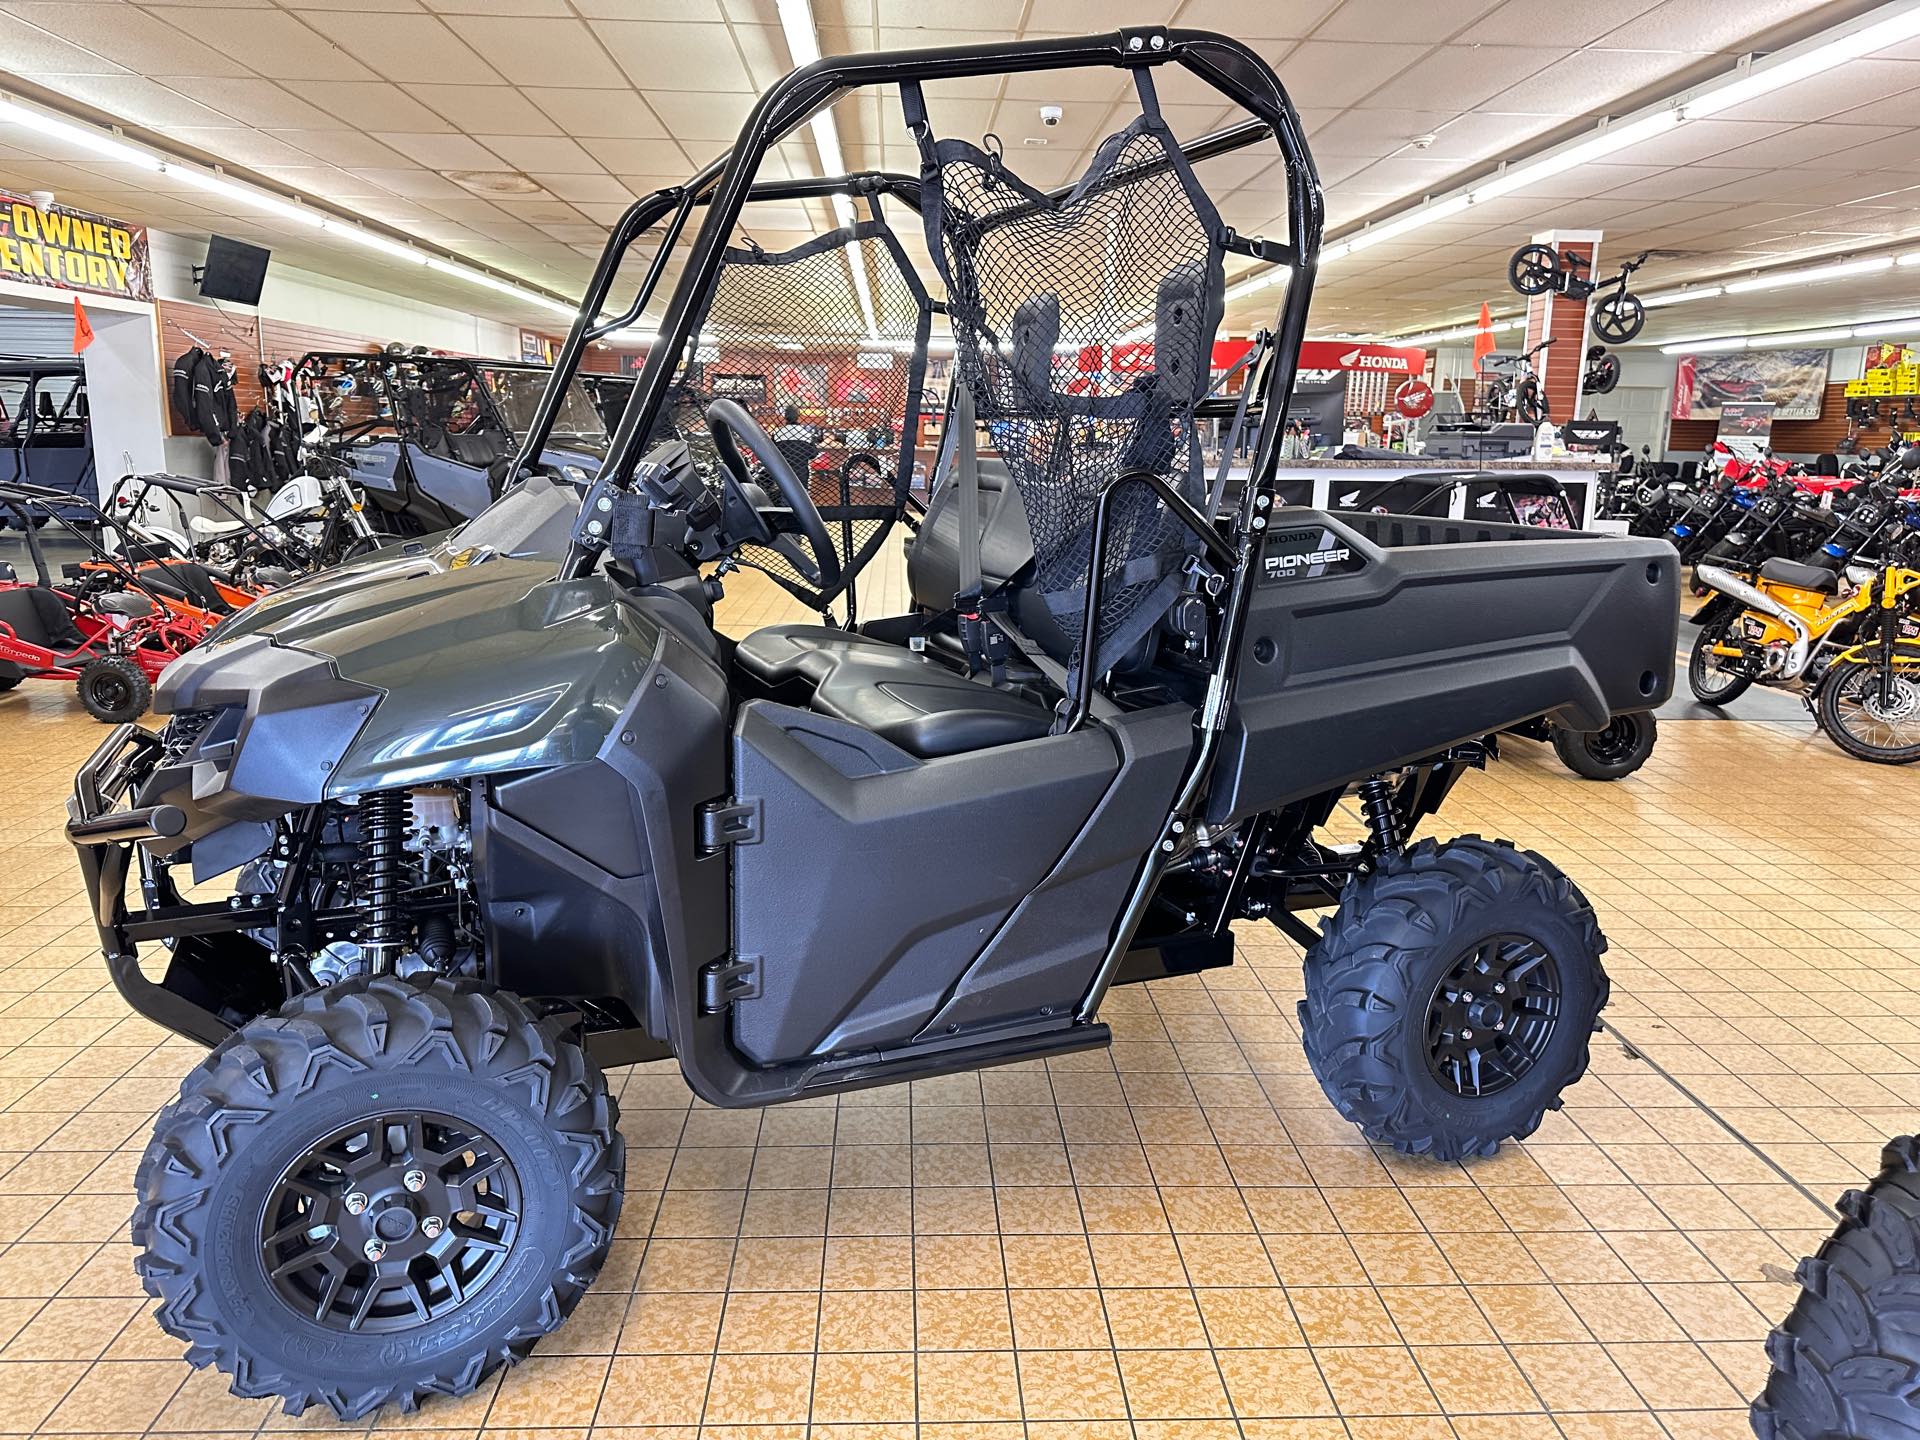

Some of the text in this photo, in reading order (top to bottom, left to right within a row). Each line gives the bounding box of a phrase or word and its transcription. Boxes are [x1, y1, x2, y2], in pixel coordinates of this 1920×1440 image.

[1359, 355, 1408, 370] HONDA
[1268, 532, 1317, 544] HONDA
[1265, 549, 1350, 570] PIONEER
[1267, 568, 1296, 579] 700
